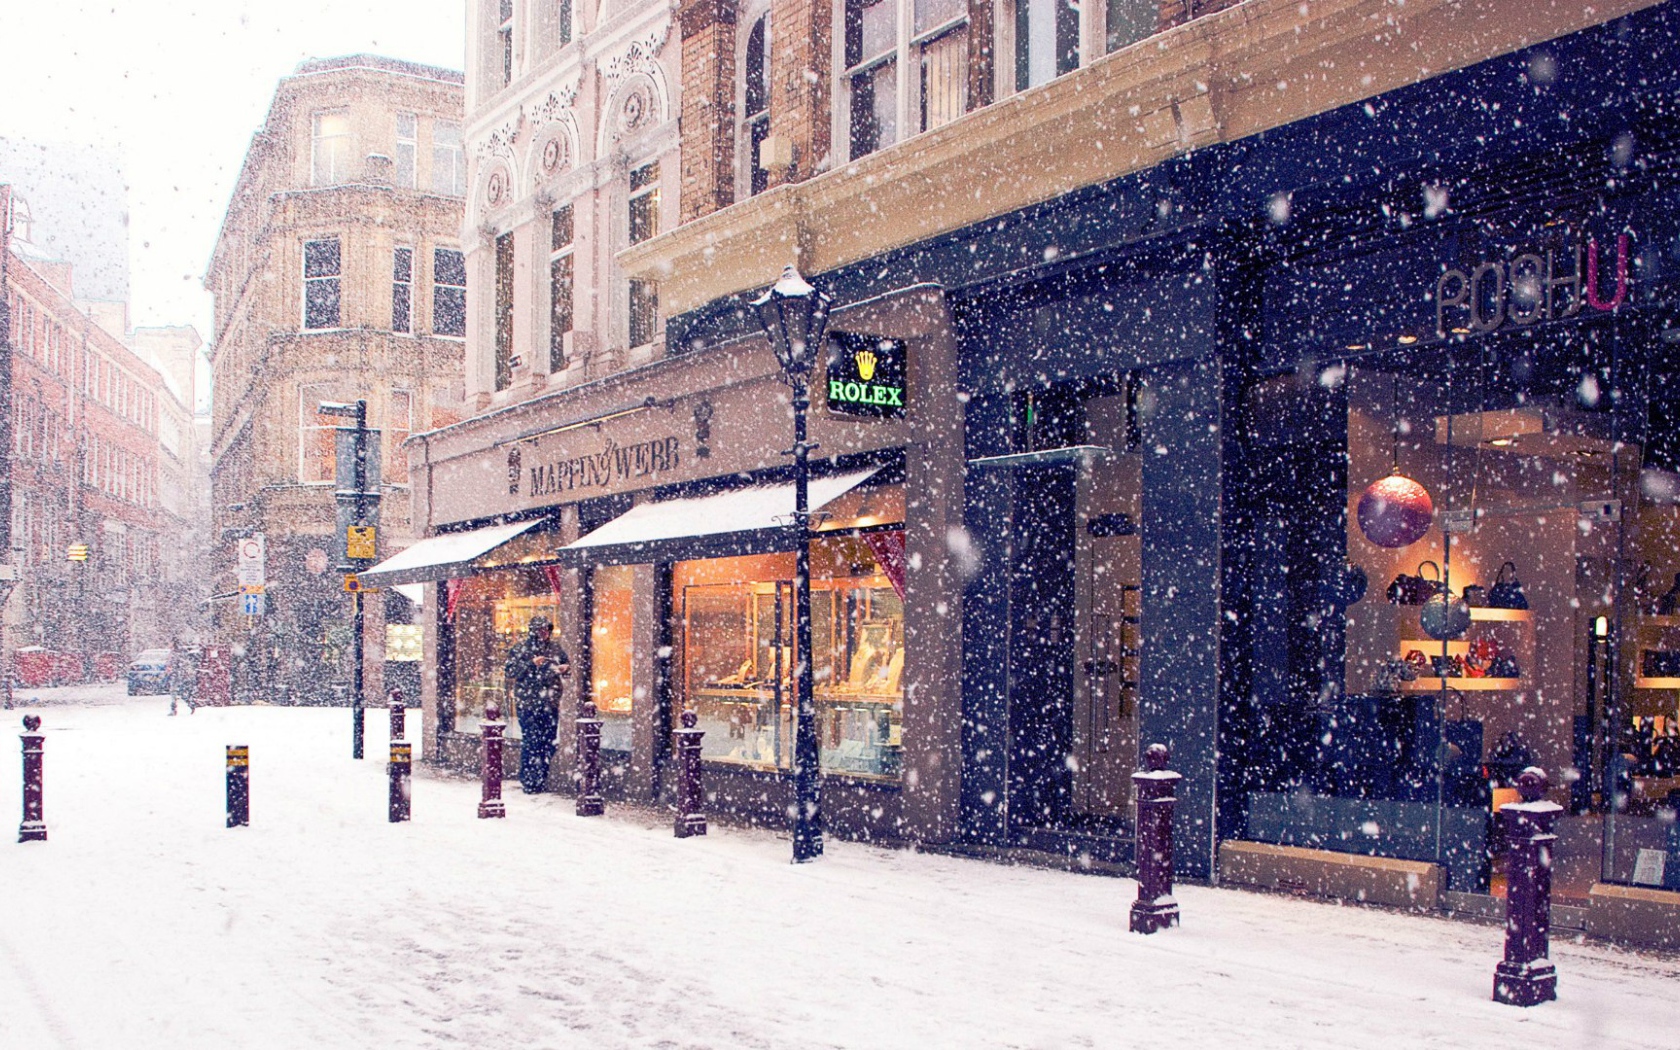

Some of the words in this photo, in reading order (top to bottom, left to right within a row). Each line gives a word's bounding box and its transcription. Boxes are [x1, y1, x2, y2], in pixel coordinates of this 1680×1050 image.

[829, 380, 903, 407] ROLEX
[529, 452, 601, 498] MAPPIN
[613, 436, 680, 480] WEBB
